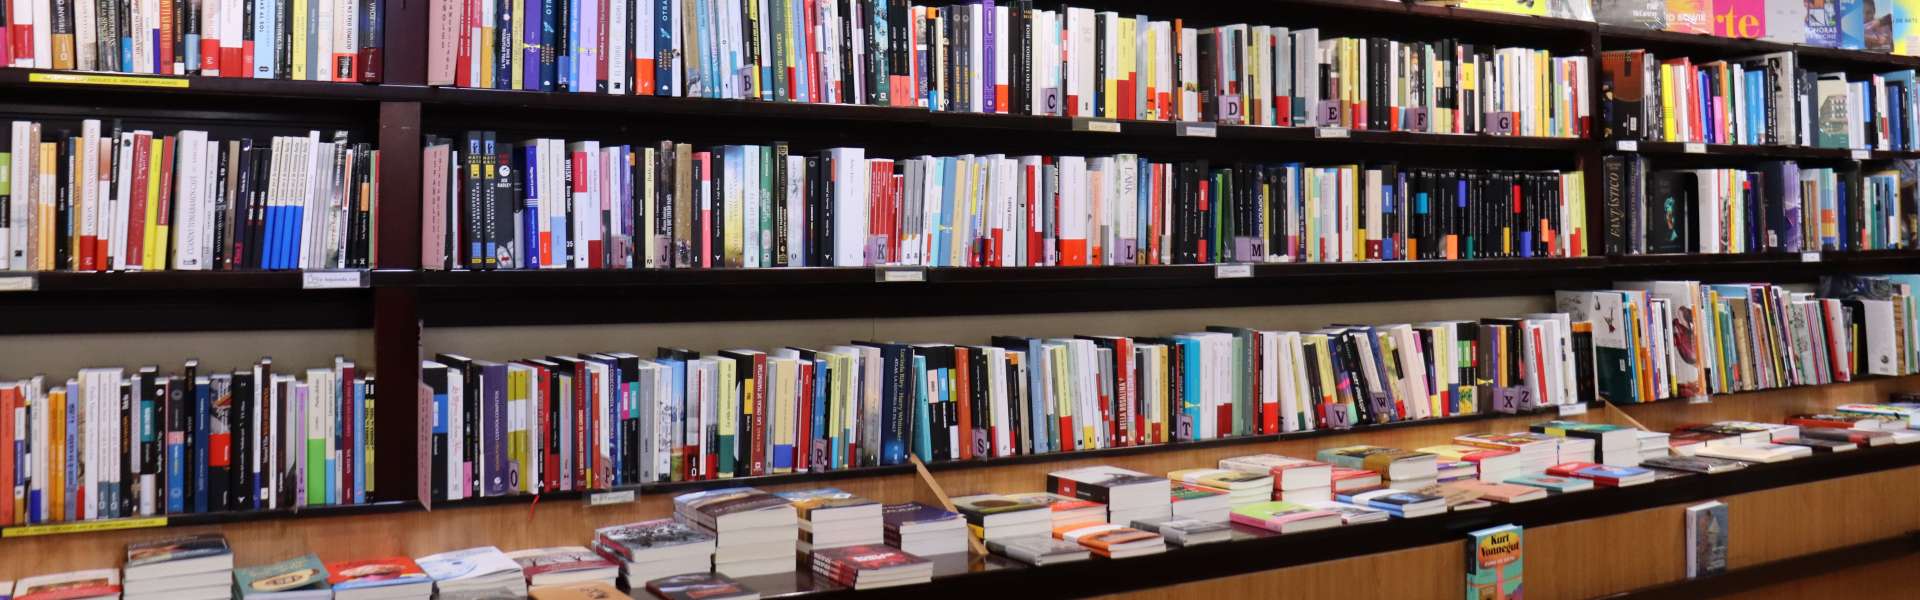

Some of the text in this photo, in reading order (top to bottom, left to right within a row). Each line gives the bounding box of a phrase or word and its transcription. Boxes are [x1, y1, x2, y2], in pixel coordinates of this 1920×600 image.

[743, 75, 752, 90] B
[1047, 94, 1056, 109] C
[1228, 102, 1238, 116] D
[1328, 107, 1338, 120] E
[1417, 113, 1426, 126] F
[1499, 117, 1509, 130] G
[565, 159, 573, 182] WHISKY
[1124, 167, 1134, 194] LARK
[1608, 172, 1625, 238] FANTÁSTICO
[661, 245, 668, 262] J
[877, 243, 886, 260] K
[1125, 245, 1134, 260] L
[1251, 243, 1262, 256] M
[1376, 396, 1387, 408] W
[1503, 395, 1513, 409] X
[1521, 390, 1529, 402] Z
[1118, 382, 1127, 430] BELLA ROSALINA
[1335, 411, 1345, 424] V
[1183, 421, 1192, 436] T
[977, 438, 985, 453] S
[815, 450, 824, 465] R
[1491, 535, 1509, 545] Kurt
[1481, 544, 1519, 556] Vonnegut
